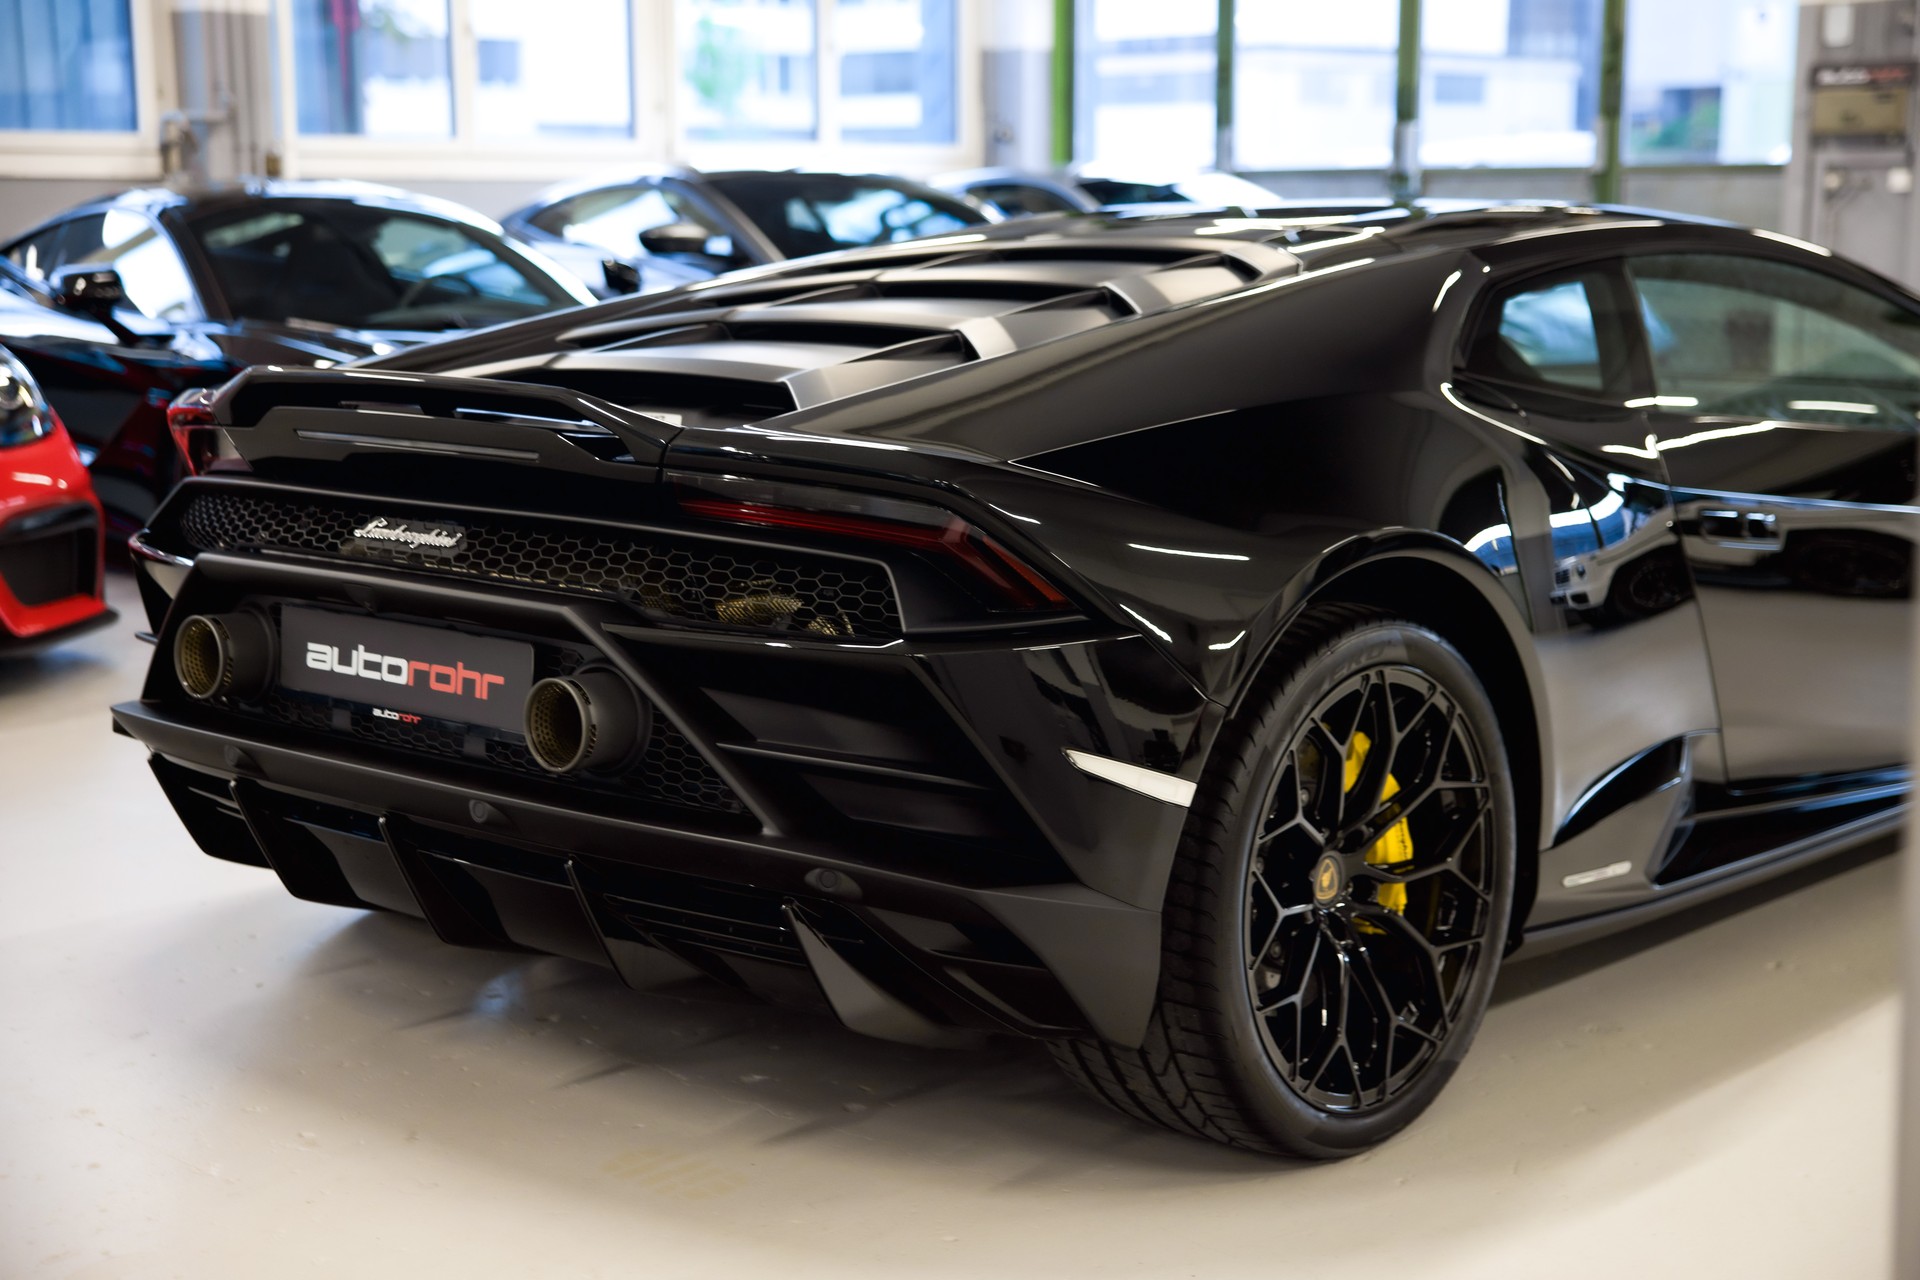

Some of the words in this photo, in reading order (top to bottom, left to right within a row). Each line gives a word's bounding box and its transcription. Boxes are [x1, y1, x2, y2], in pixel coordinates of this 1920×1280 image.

[353, 517, 463, 549] Lamborghini
[306, 642, 505, 700] autorohr
[372, 707, 422, 724] autorohr
